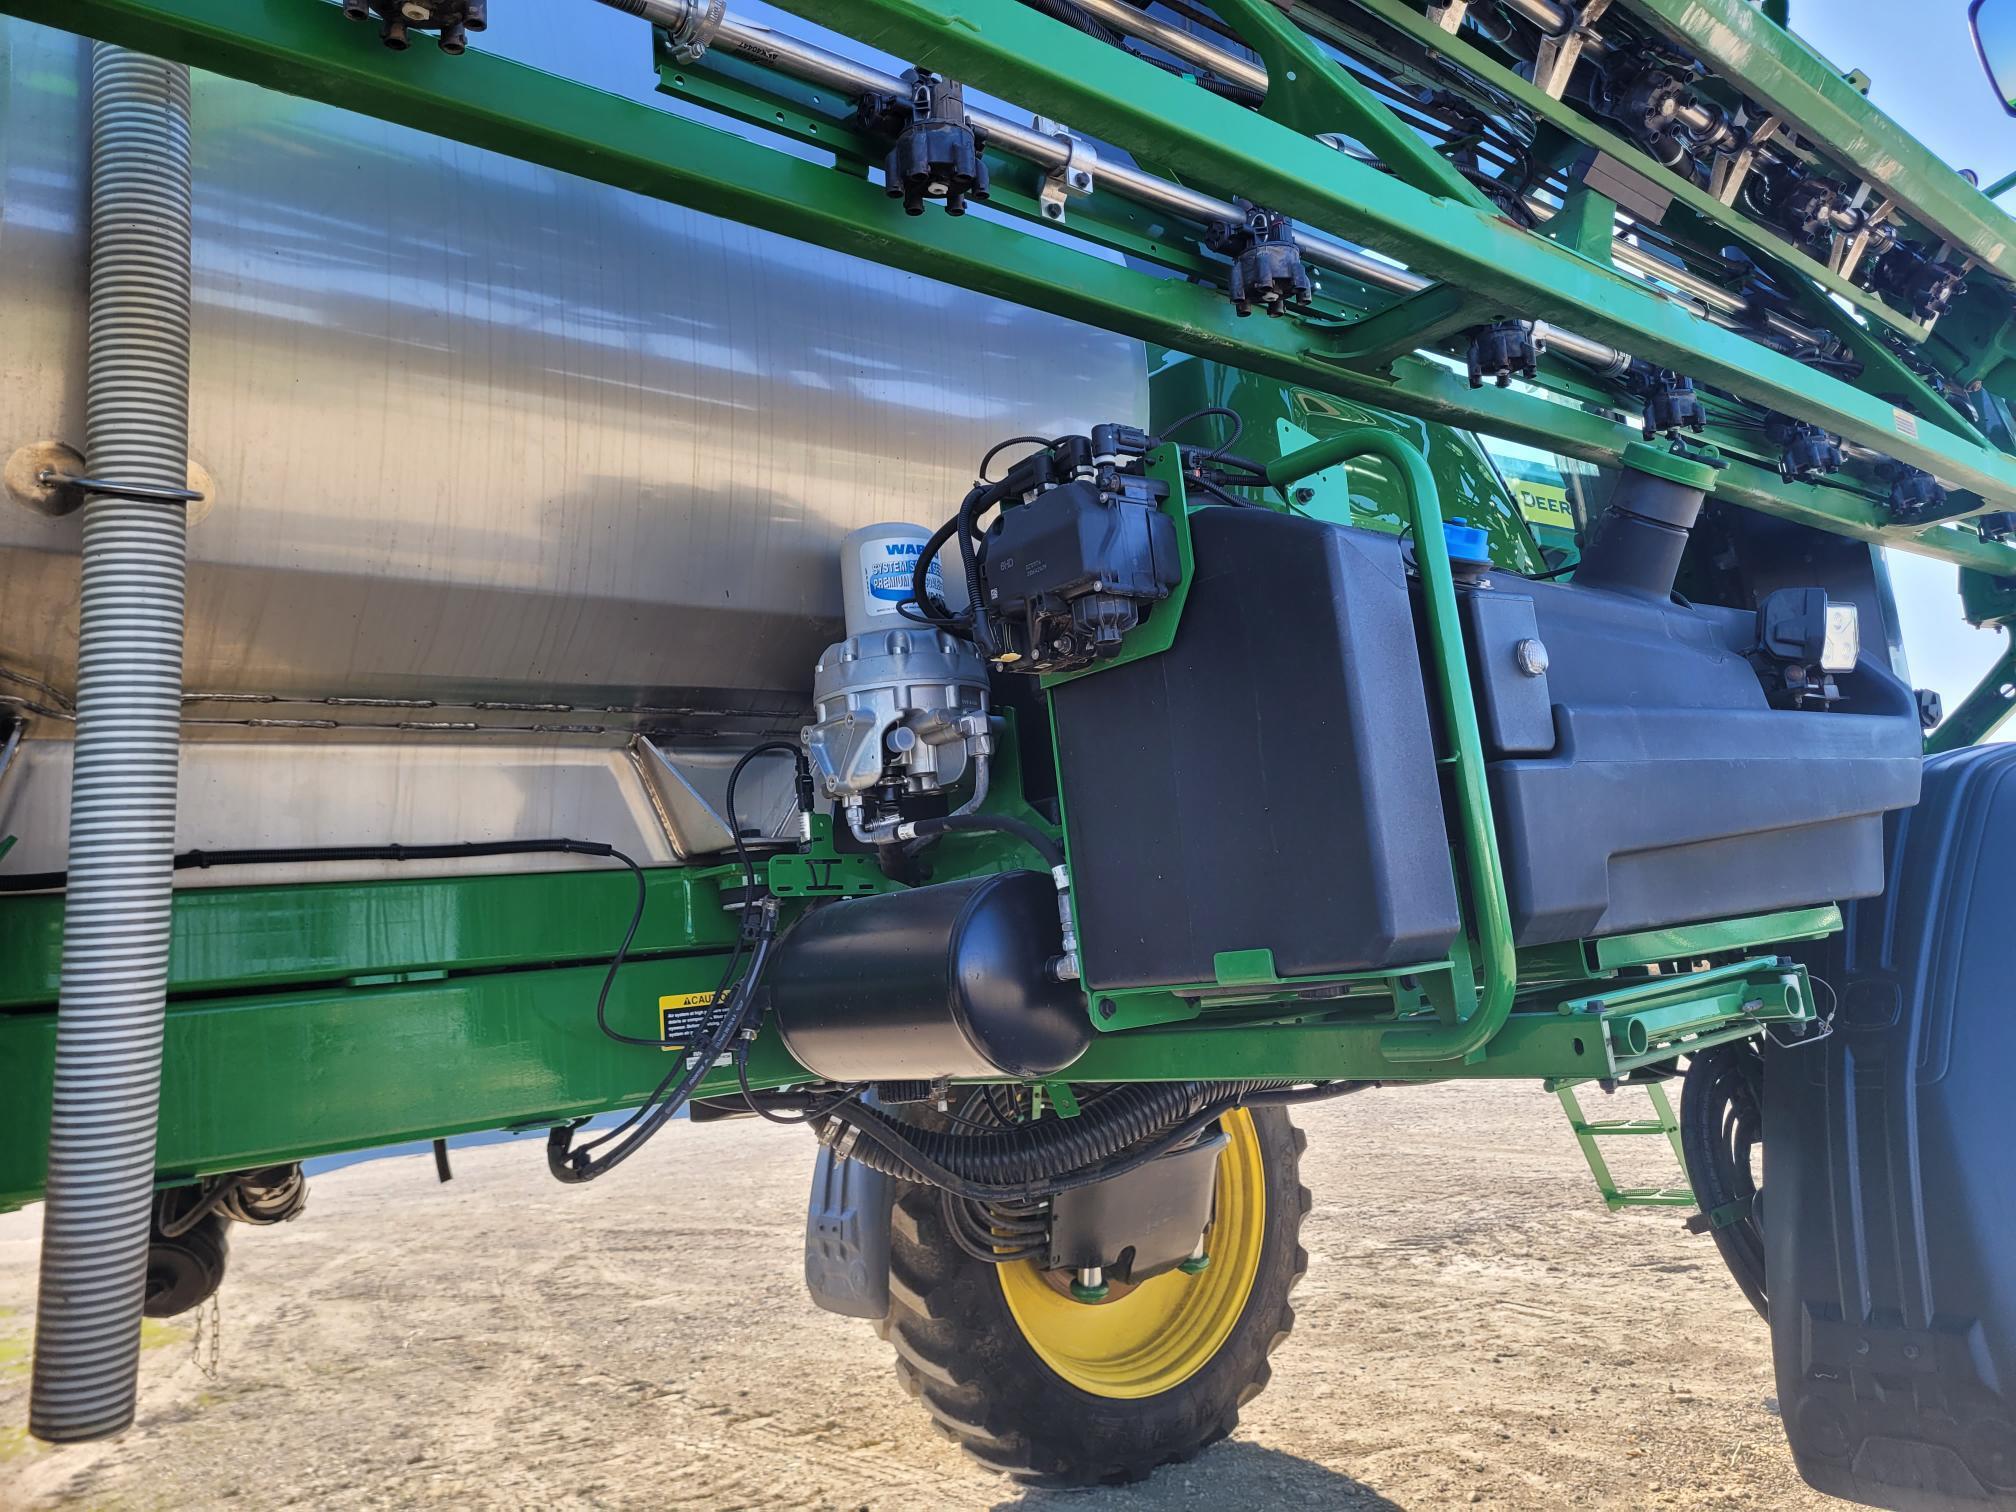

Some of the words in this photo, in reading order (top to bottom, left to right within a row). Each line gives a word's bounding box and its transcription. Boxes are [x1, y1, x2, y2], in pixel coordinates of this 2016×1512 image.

[886, 543, 939, 559] WAB
[872, 561, 907, 574] SYSTEM
[873, 574, 910, 589] PREMIUM
